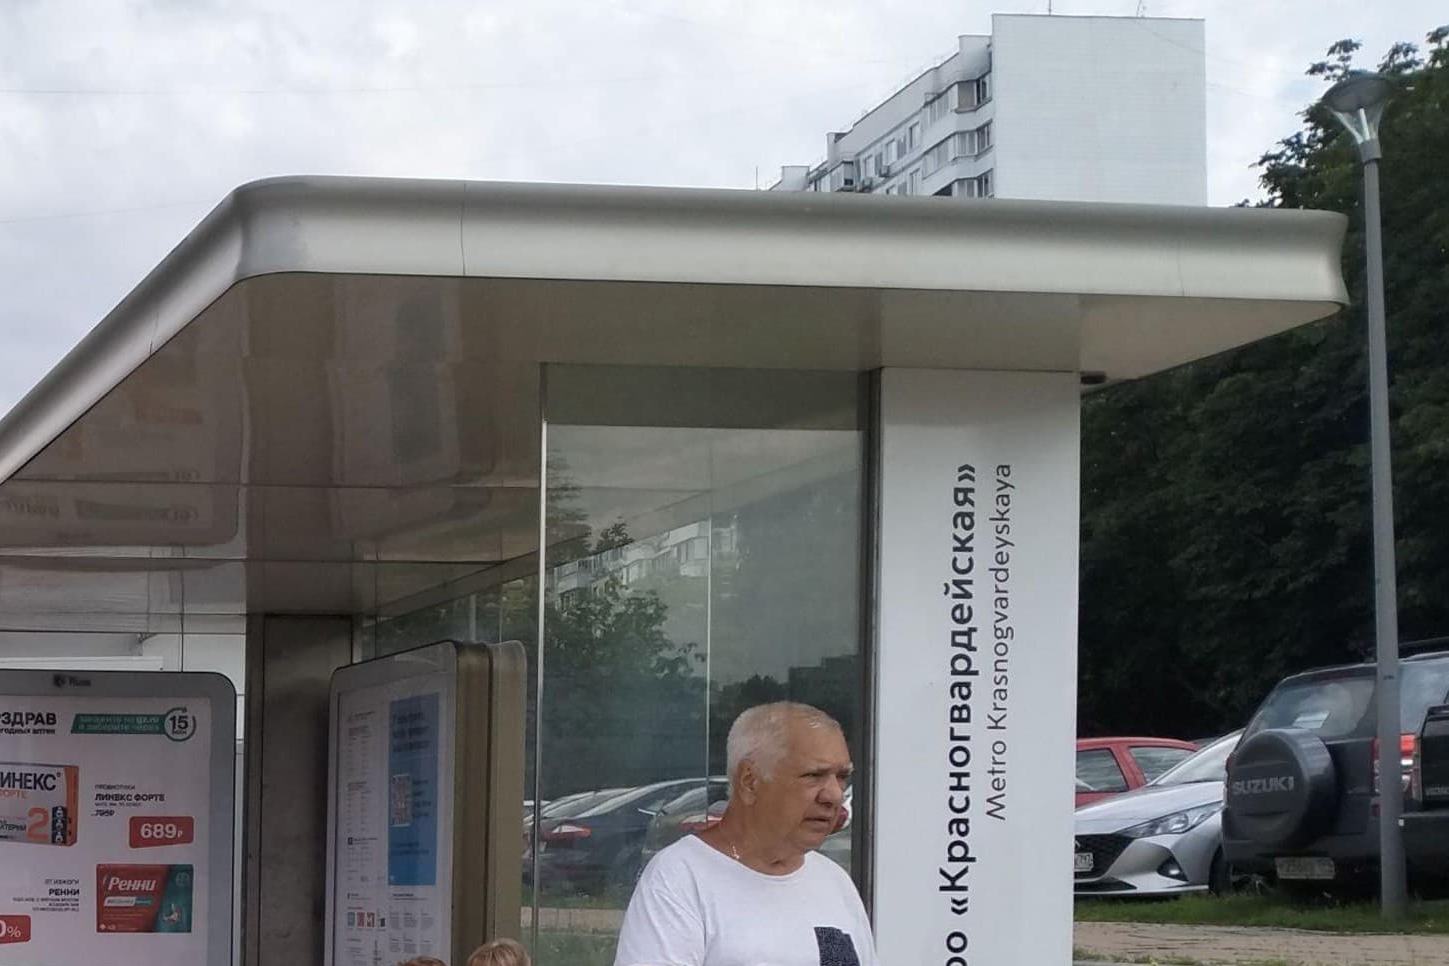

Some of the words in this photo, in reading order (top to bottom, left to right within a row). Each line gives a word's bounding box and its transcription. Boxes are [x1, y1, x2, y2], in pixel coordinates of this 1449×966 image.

[987, 463, 1015, 730] Krasnogvardeyskaya
[939, 463, 979, 915] «Красногвардейская»
[169, 715, 189, 730] 15
[986, 740, 1007, 820] Metro
[1232, 775, 1295, 796] SUZUKI
[94, 793, 133, 802] ЛИНЕКС
[134, 793, 166, 802] ФОРТЕ
[27, 806, 50, 840] 2
[48, 888, 80, 896] РЕННИ
[108, 876, 157, 891] Ренни
